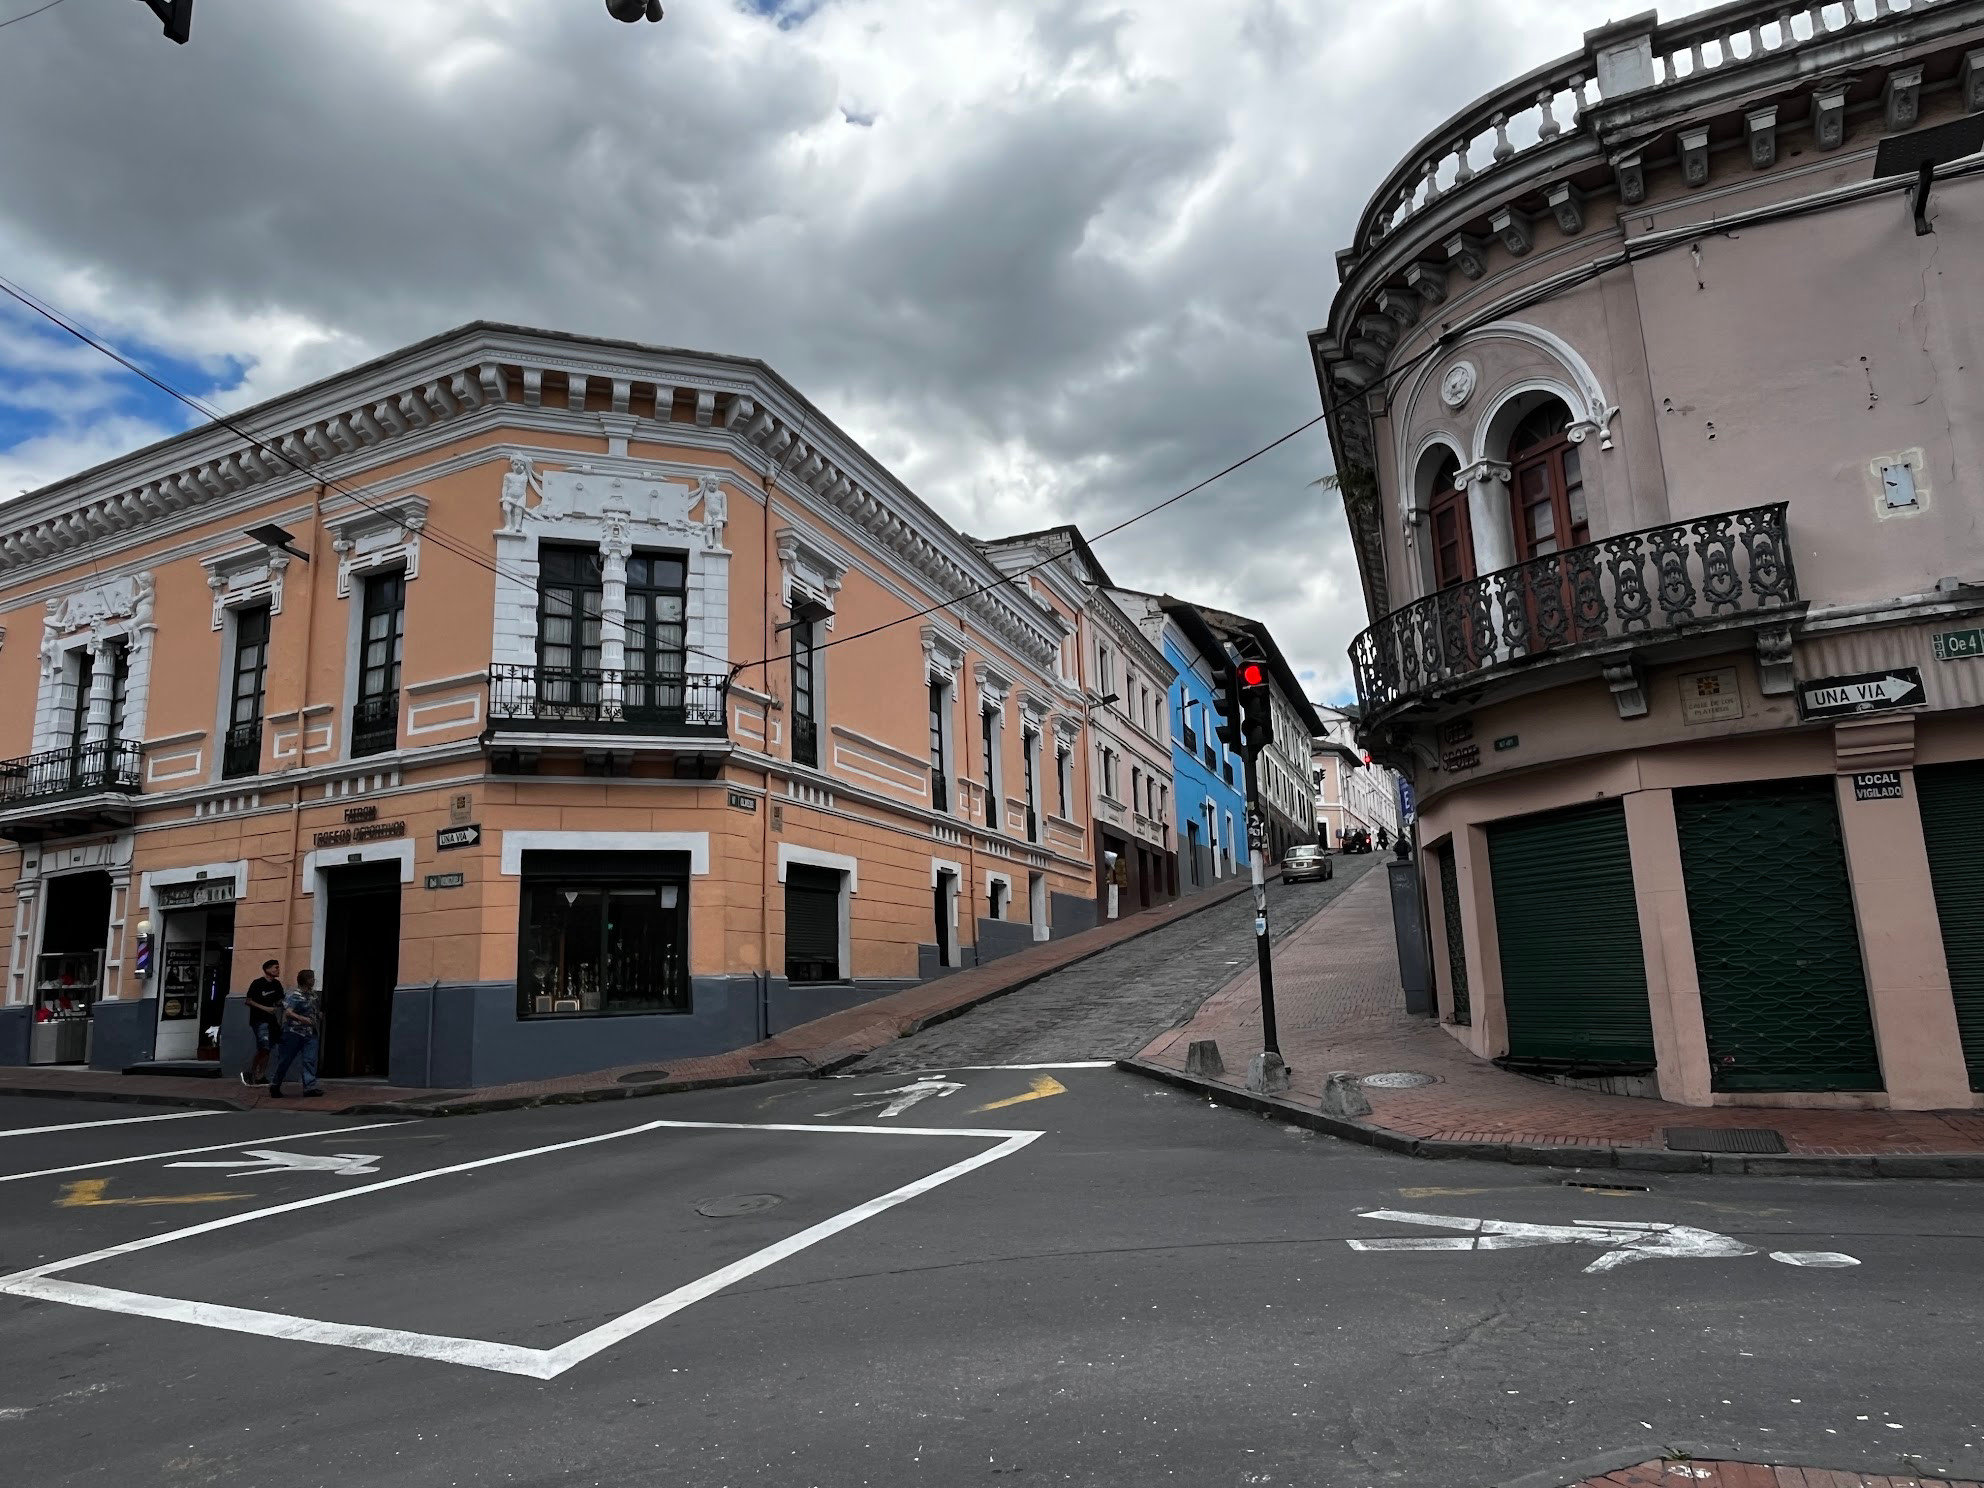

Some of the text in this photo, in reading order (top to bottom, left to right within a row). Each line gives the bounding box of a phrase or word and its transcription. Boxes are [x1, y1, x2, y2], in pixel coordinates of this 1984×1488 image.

[1814, 683, 1886, 705] UNA VIA
[1857, 773, 1899, 786] LOCAL
[1856, 786, 1903, 799] VIGILADO
[441, 831, 467, 845] UNA VIA
